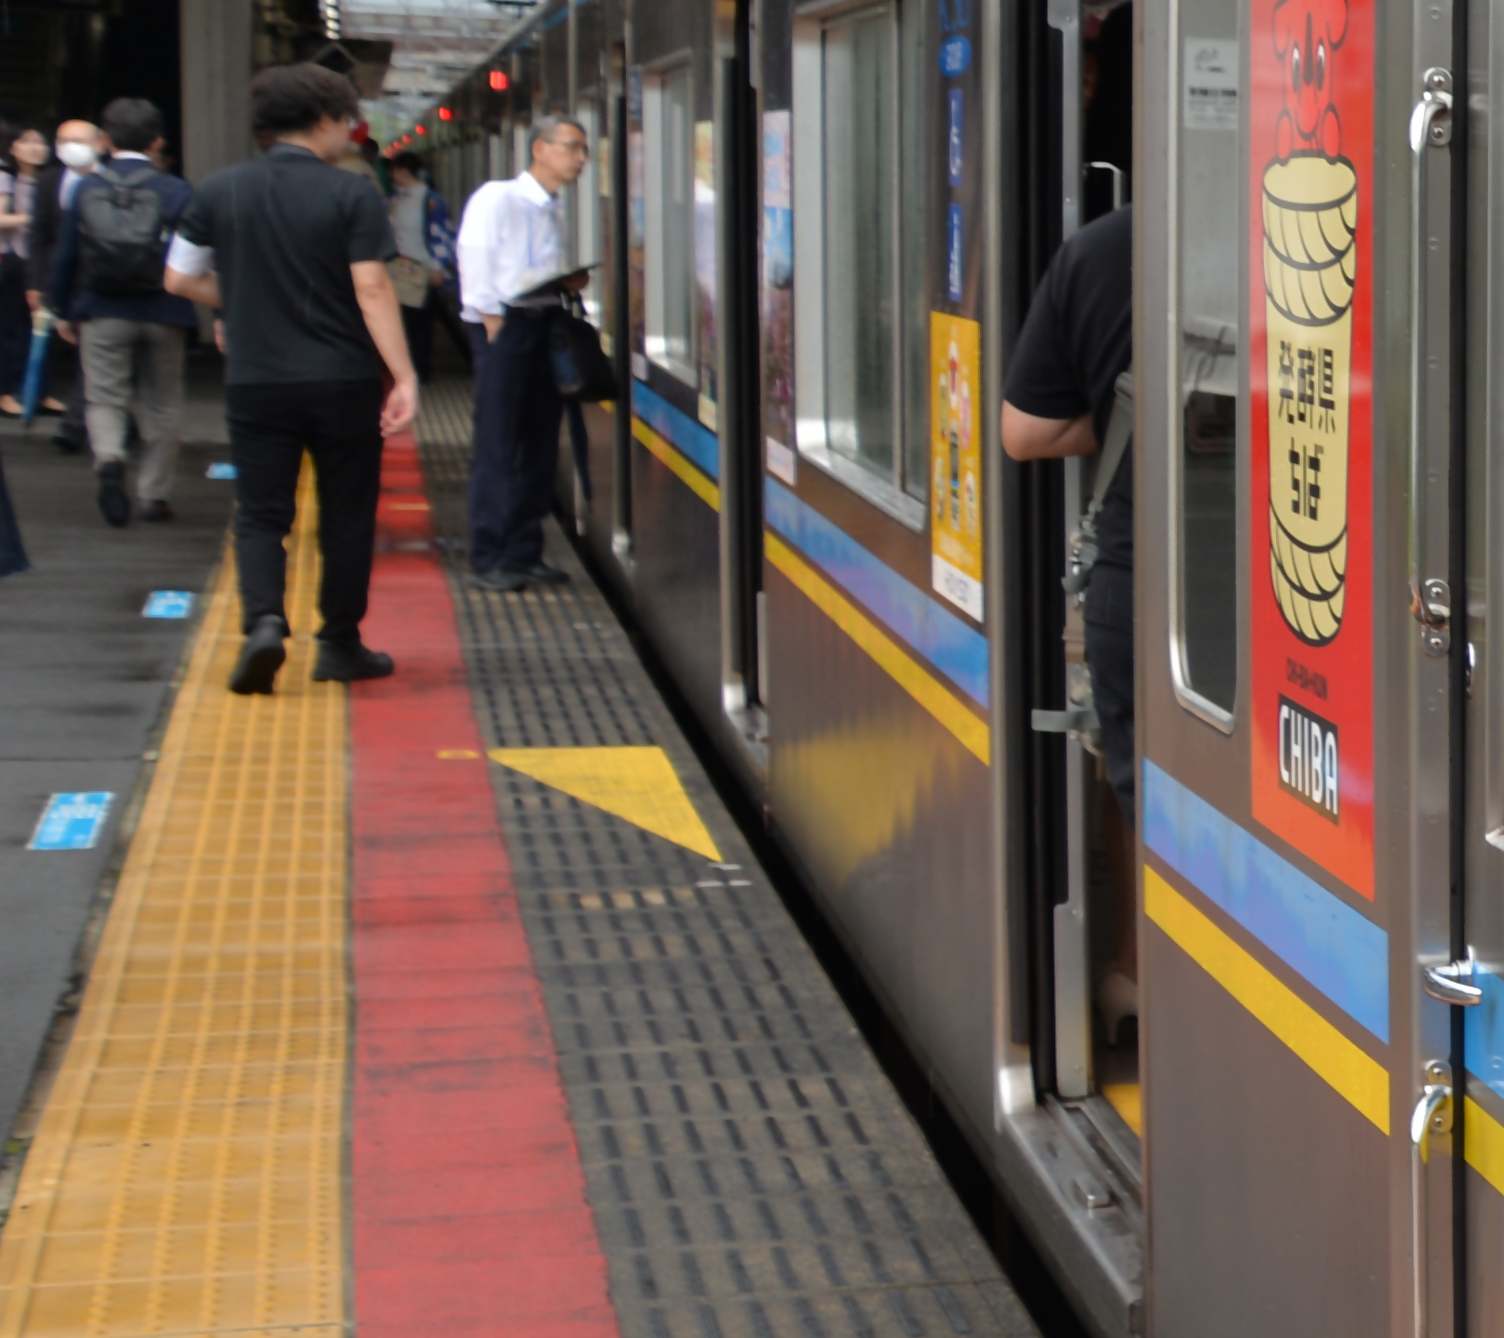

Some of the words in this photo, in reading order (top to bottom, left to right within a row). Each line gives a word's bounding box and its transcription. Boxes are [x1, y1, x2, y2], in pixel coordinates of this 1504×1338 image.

[1278, 339, 1336, 435] 発酵県
[1288, 436, 1325, 522] ちば
[1278, 703, 1339, 816] CHIBA
